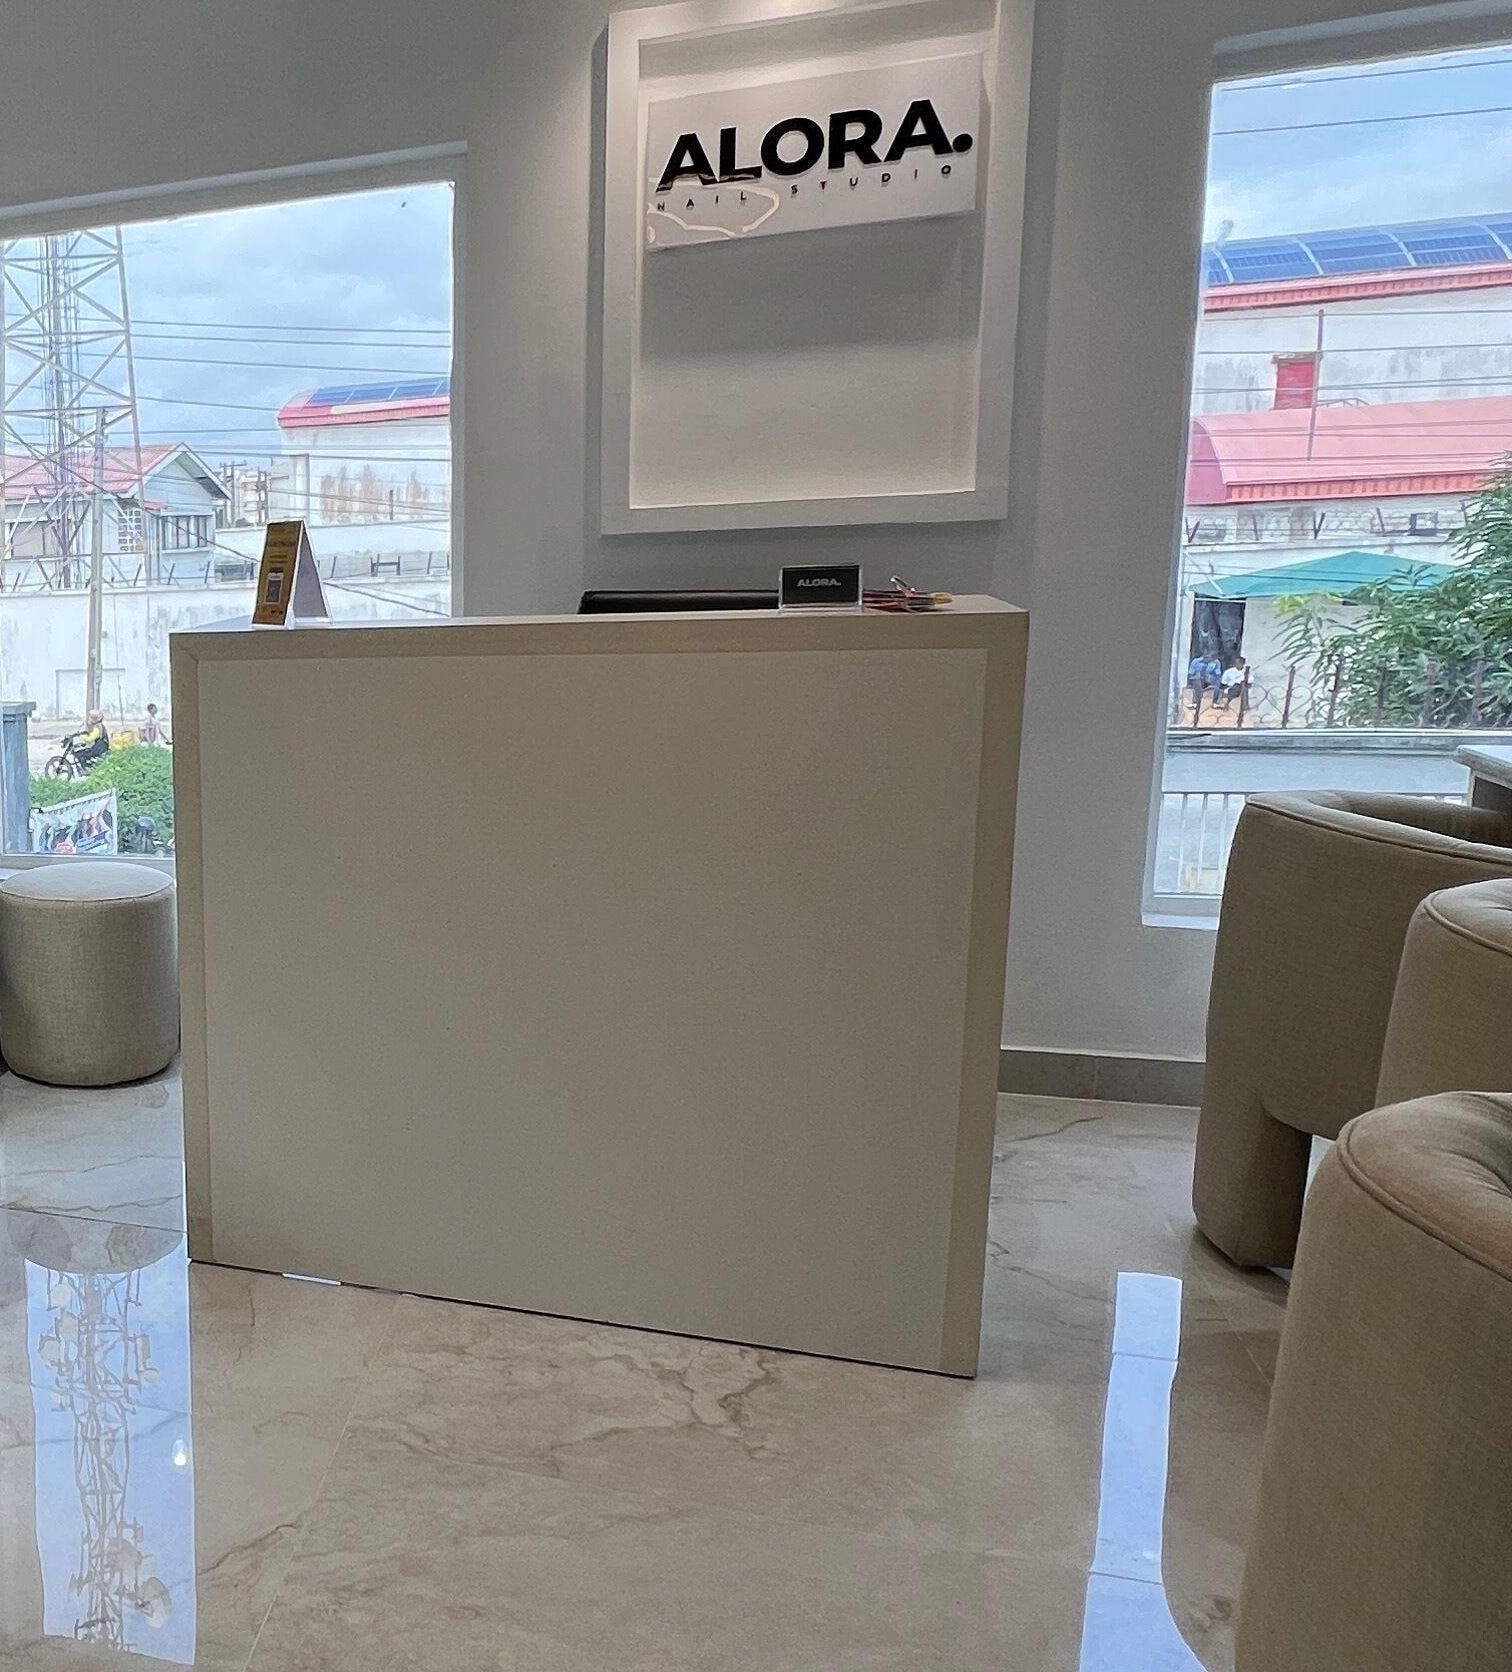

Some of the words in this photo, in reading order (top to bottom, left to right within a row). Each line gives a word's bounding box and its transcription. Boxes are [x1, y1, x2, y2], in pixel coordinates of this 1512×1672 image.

[655, 98, 974, 193] ALORA.
[656, 191, 747, 212] NAIL
[790, 164, 952, 195] STUDIO
